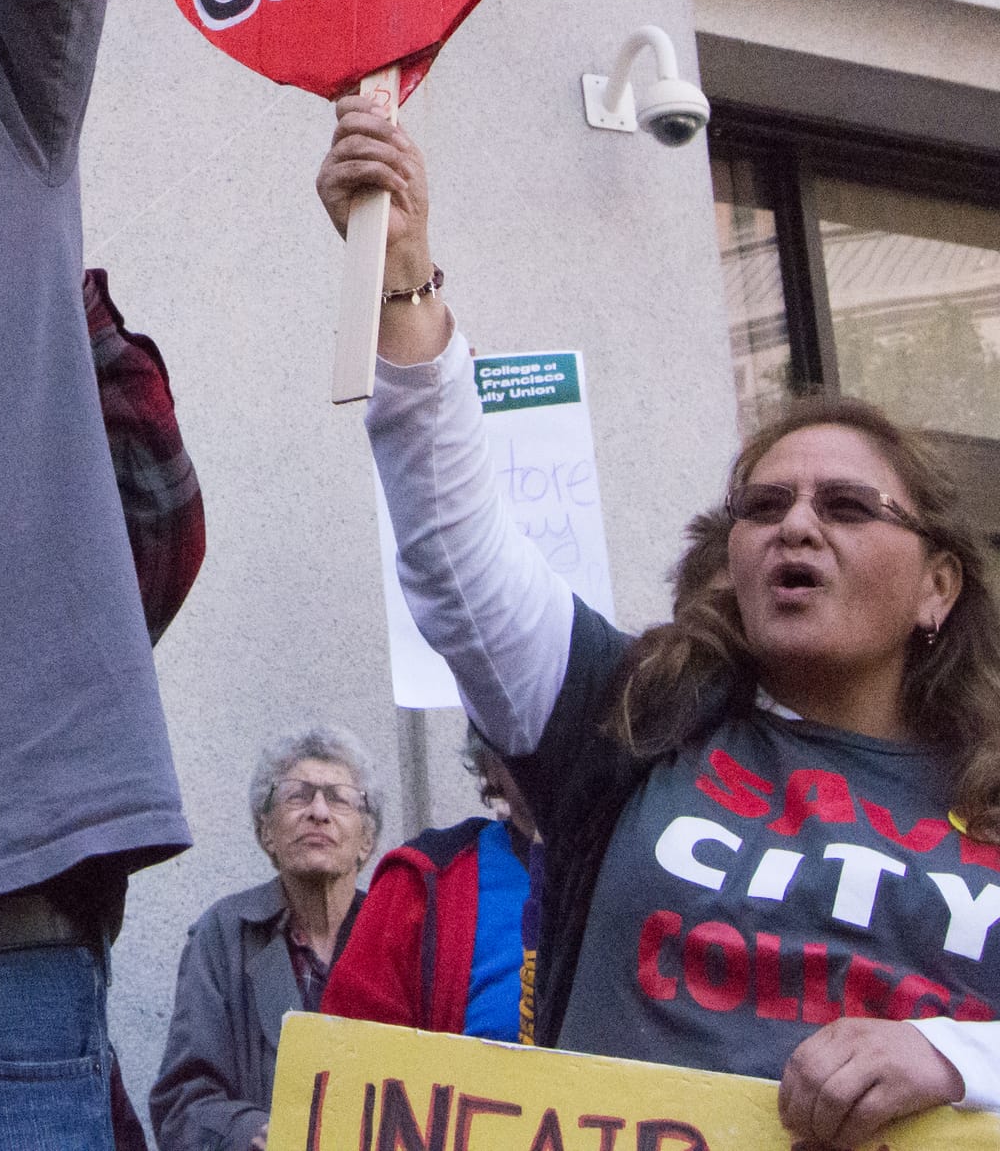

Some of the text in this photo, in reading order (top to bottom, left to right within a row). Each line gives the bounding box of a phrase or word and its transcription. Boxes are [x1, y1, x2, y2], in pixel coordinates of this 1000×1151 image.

[479, 362, 557, 378] College of
[482, 373, 565, 390] Francisco
[509, 386, 556, 398] Union
[655, 815, 1000, 963] CITY
